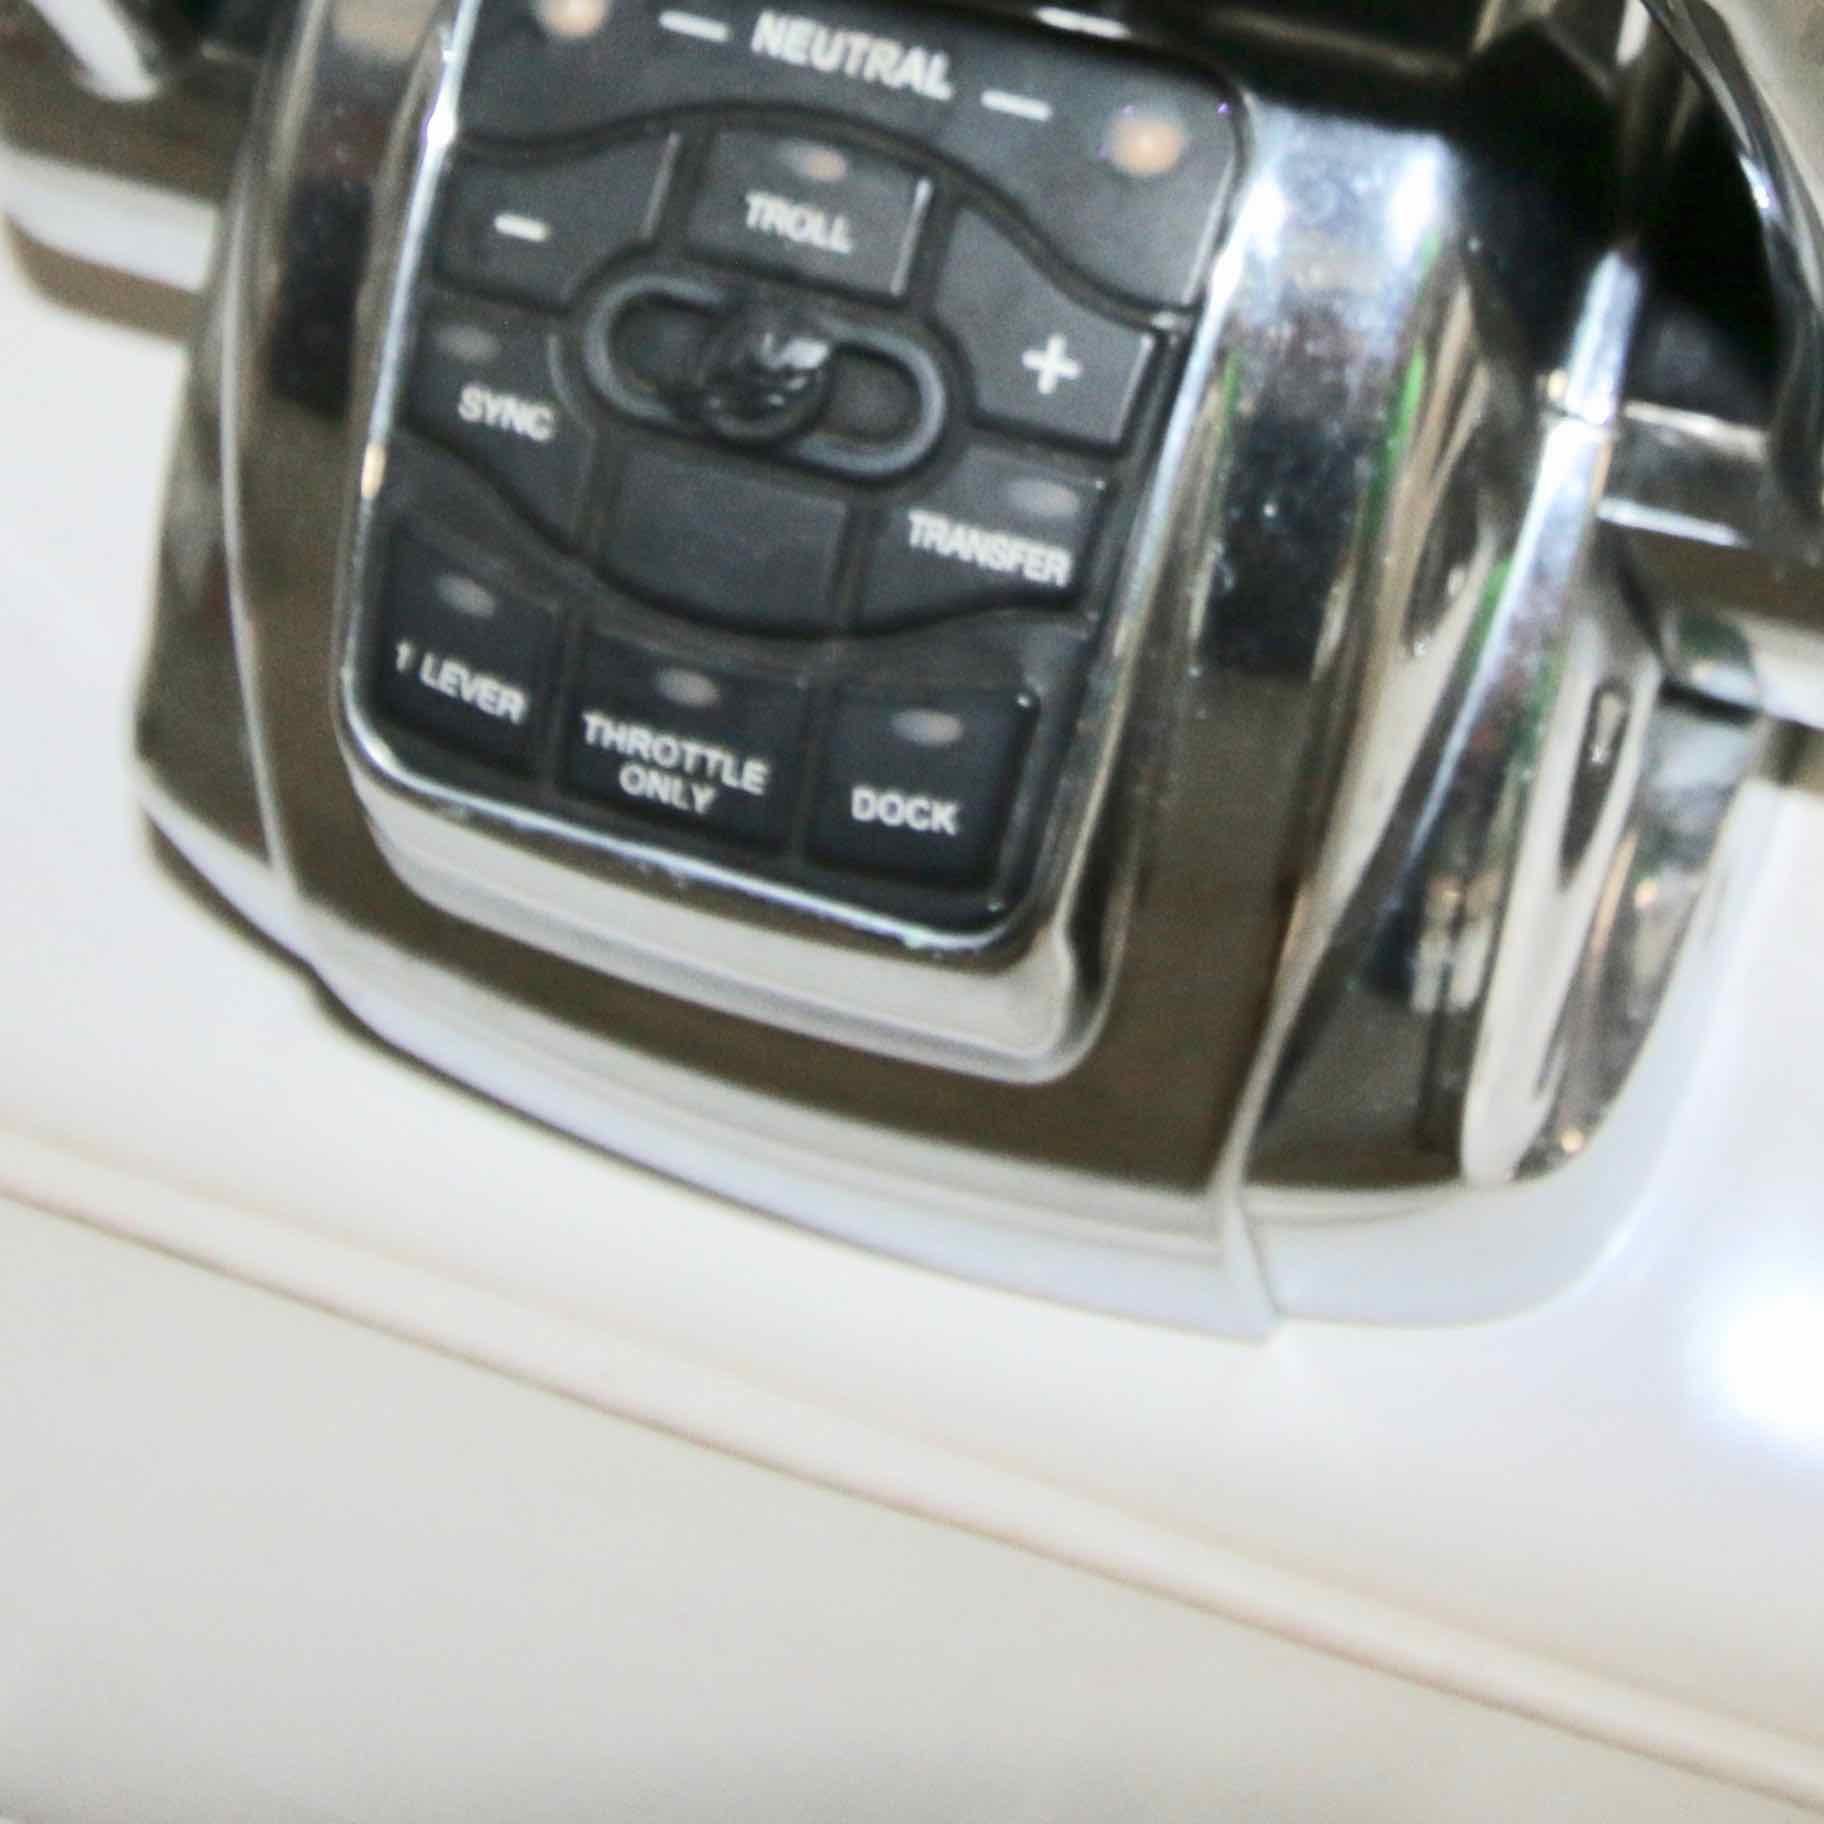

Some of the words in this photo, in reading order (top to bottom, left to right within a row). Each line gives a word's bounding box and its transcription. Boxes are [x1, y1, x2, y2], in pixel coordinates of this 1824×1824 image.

[751, 12, 954, 98] NEUTRAL
[745, 190, 853, 255] TROLL
[458, 384, 556, 443] SYNC
[909, 509, 1072, 587] TRANSFER
[420, 652, 528, 727] LEVER
[583, 711, 771, 796] THROTTLE
[619, 763, 717, 816] ONLY
[850, 785, 962, 837] DOCK
